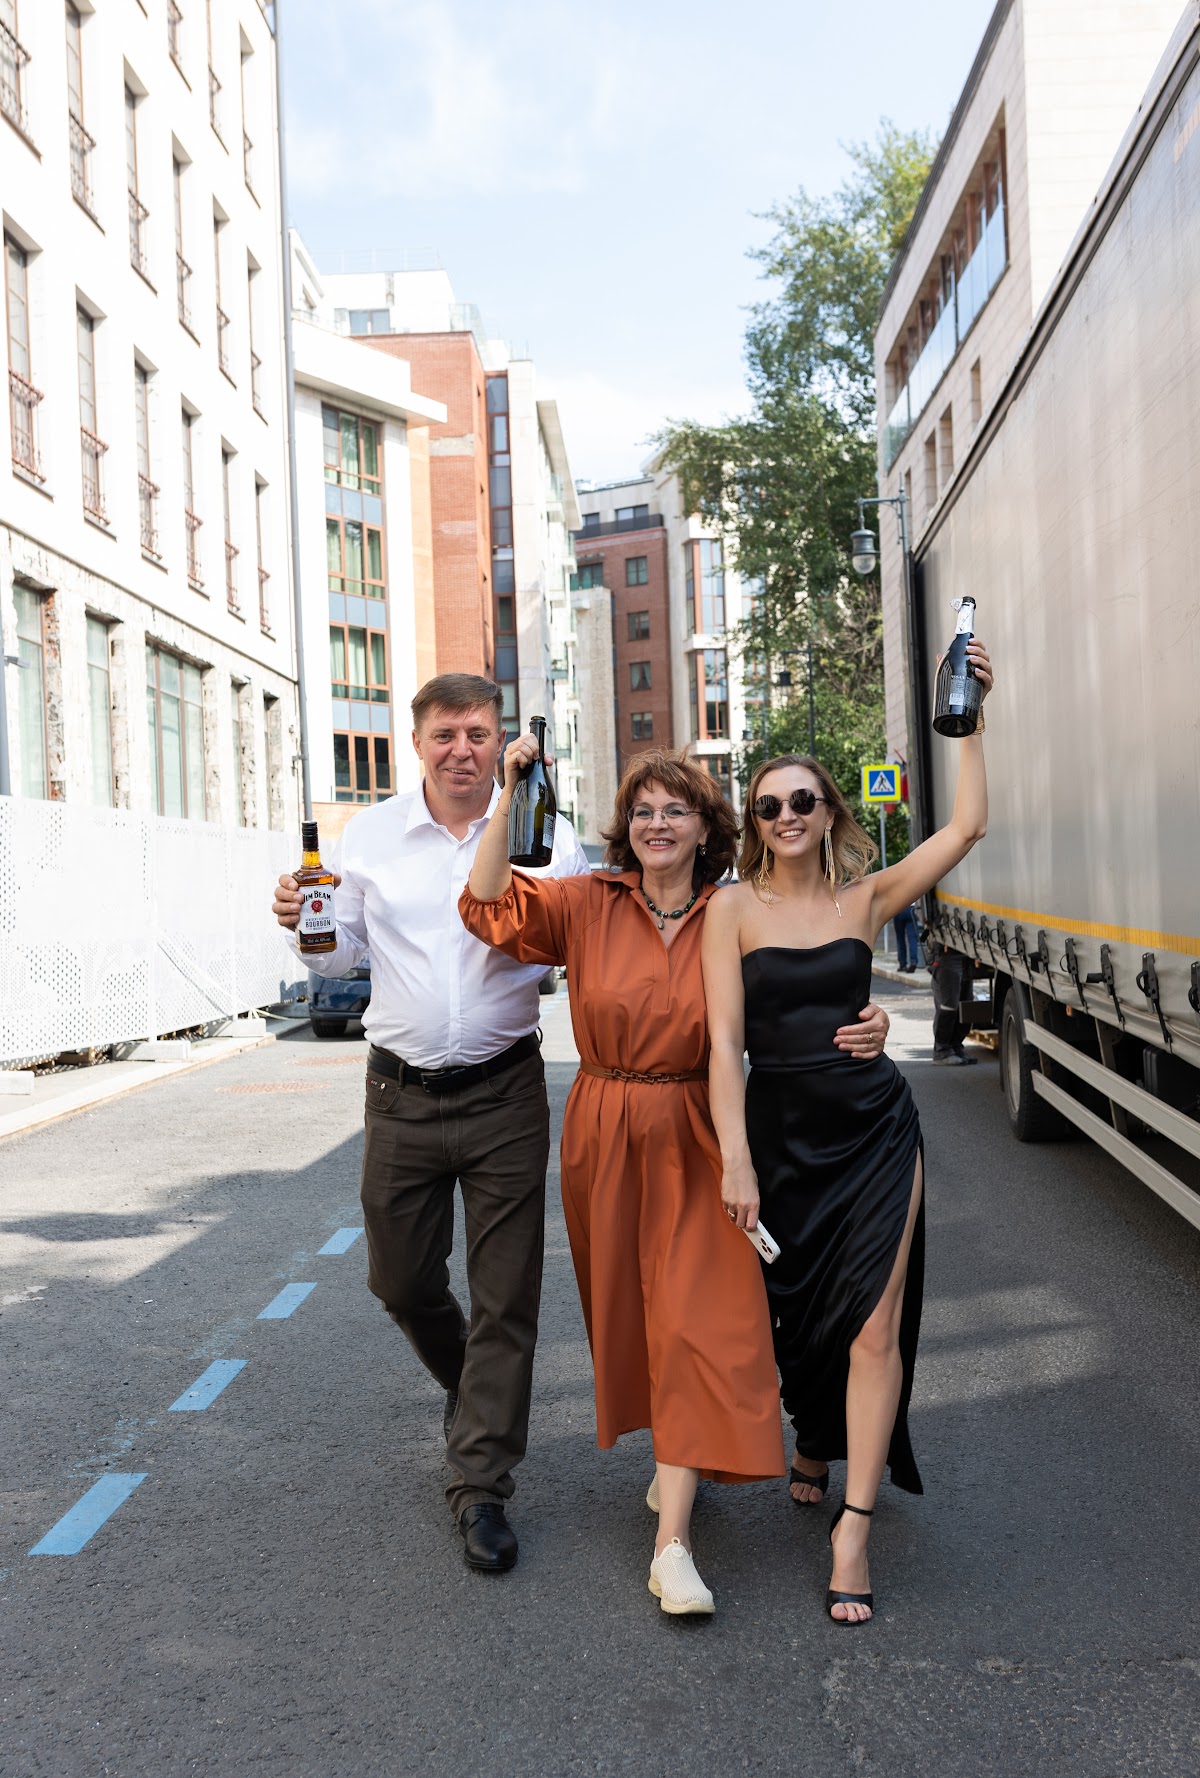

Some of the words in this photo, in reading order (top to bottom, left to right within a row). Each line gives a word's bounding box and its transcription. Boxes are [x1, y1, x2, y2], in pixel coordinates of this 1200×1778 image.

[302, 893, 313, 904] JIM
[314, 890, 332, 902] BEAM
[305, 919, 331, 928] BOURBON
